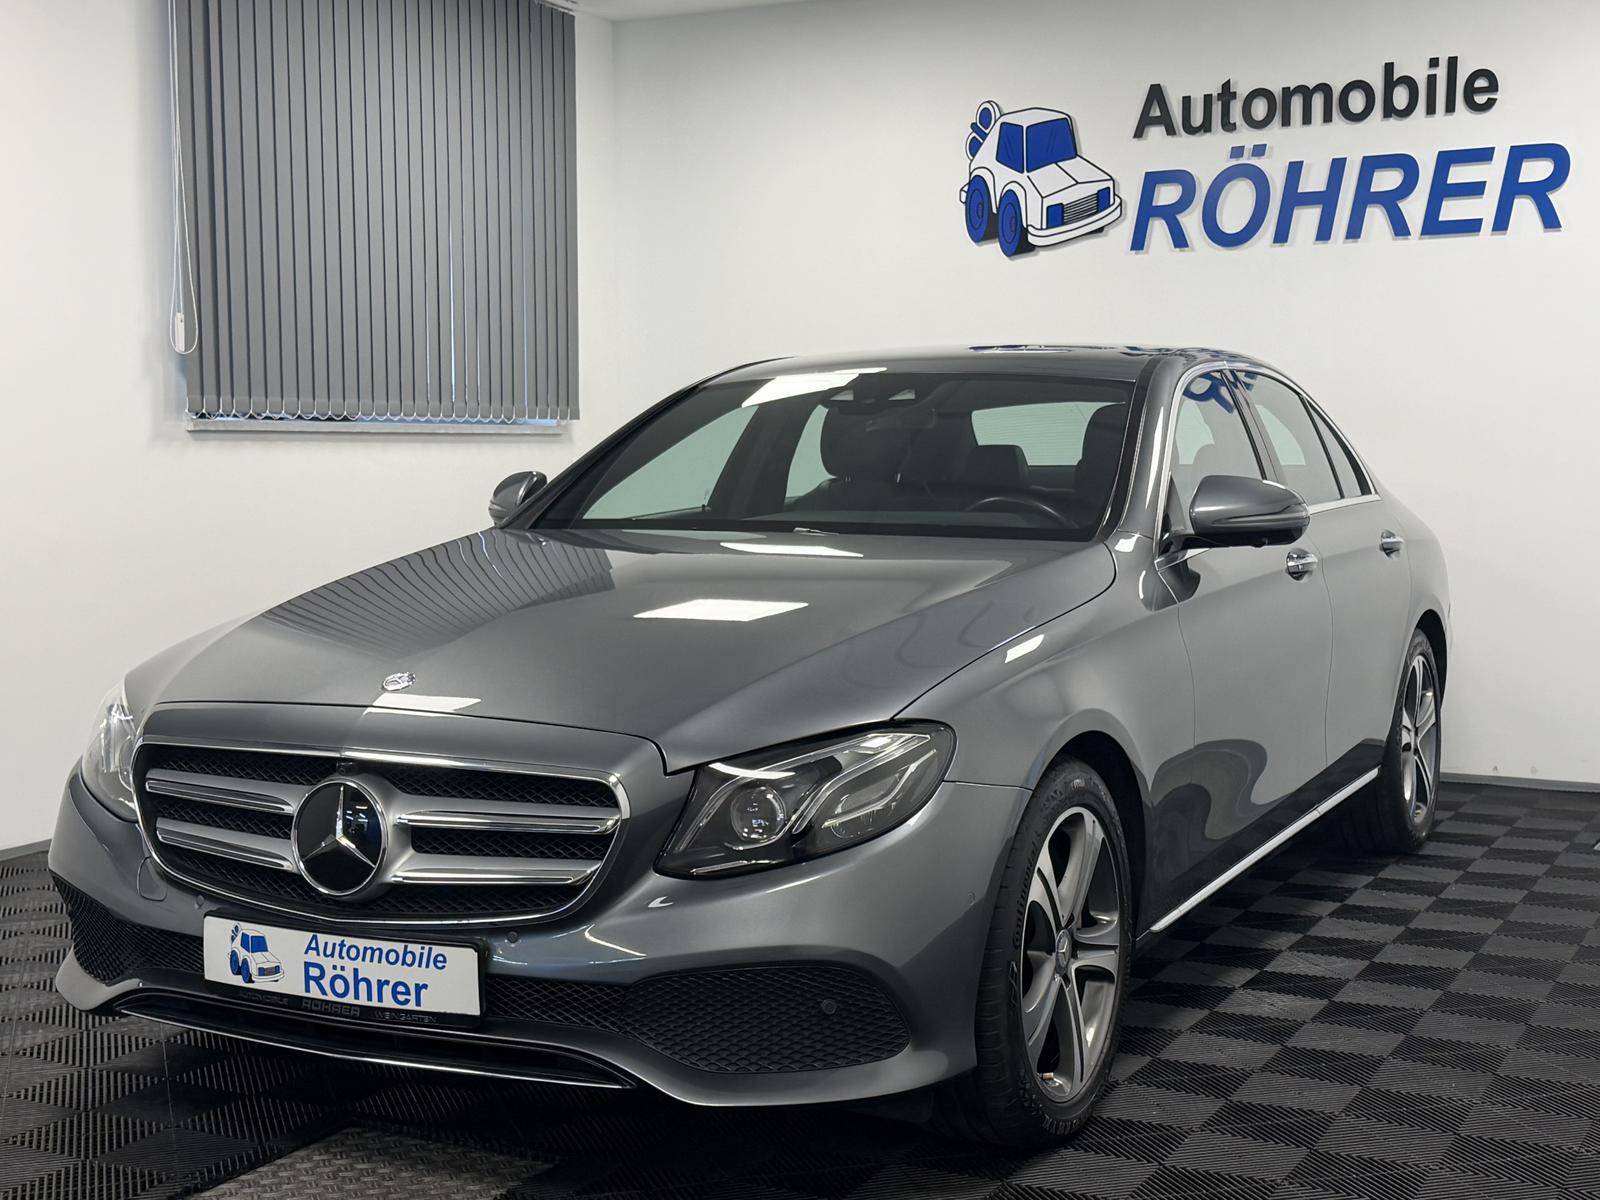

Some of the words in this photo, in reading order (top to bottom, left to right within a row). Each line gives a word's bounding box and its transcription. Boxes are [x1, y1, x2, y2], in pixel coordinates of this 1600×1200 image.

[1133, 56, 1499, 139] Automobile
[1130, 143, 1571, 252] RÖHRER
[303, 961, 429, 1007] Röhrer
[304, 934, 447, 970] Automobile
